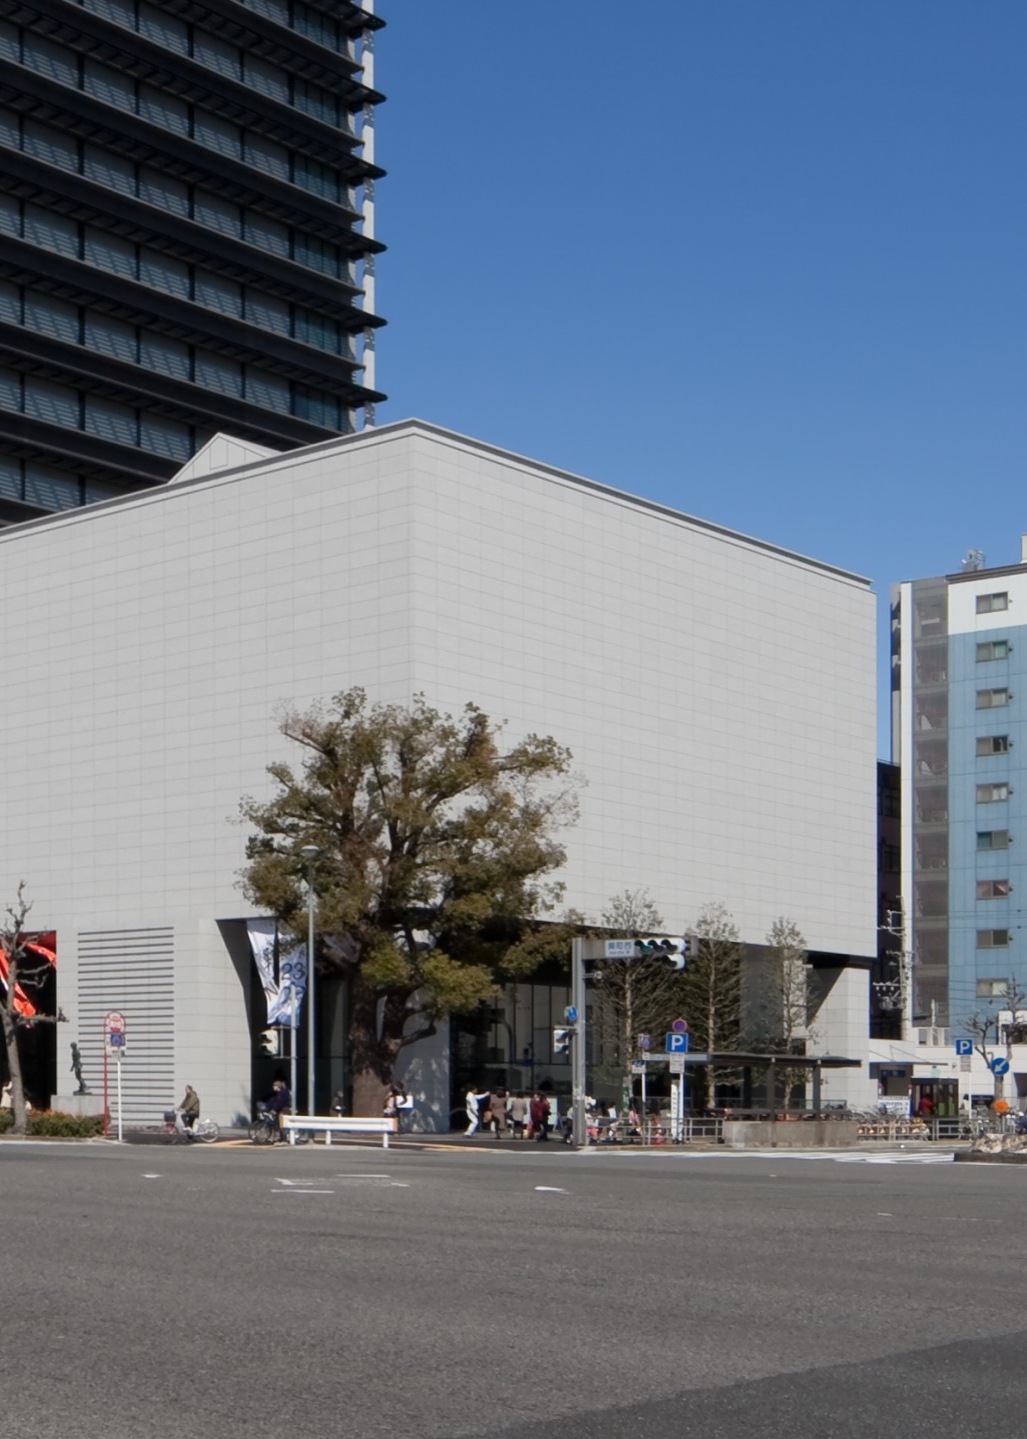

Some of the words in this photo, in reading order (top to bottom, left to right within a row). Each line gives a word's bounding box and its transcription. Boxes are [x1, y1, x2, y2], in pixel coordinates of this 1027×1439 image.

[281, 962, 306, 981] 23
[671, 1035, 684, 1051] P
[960, 1041, 970, 1053] P
